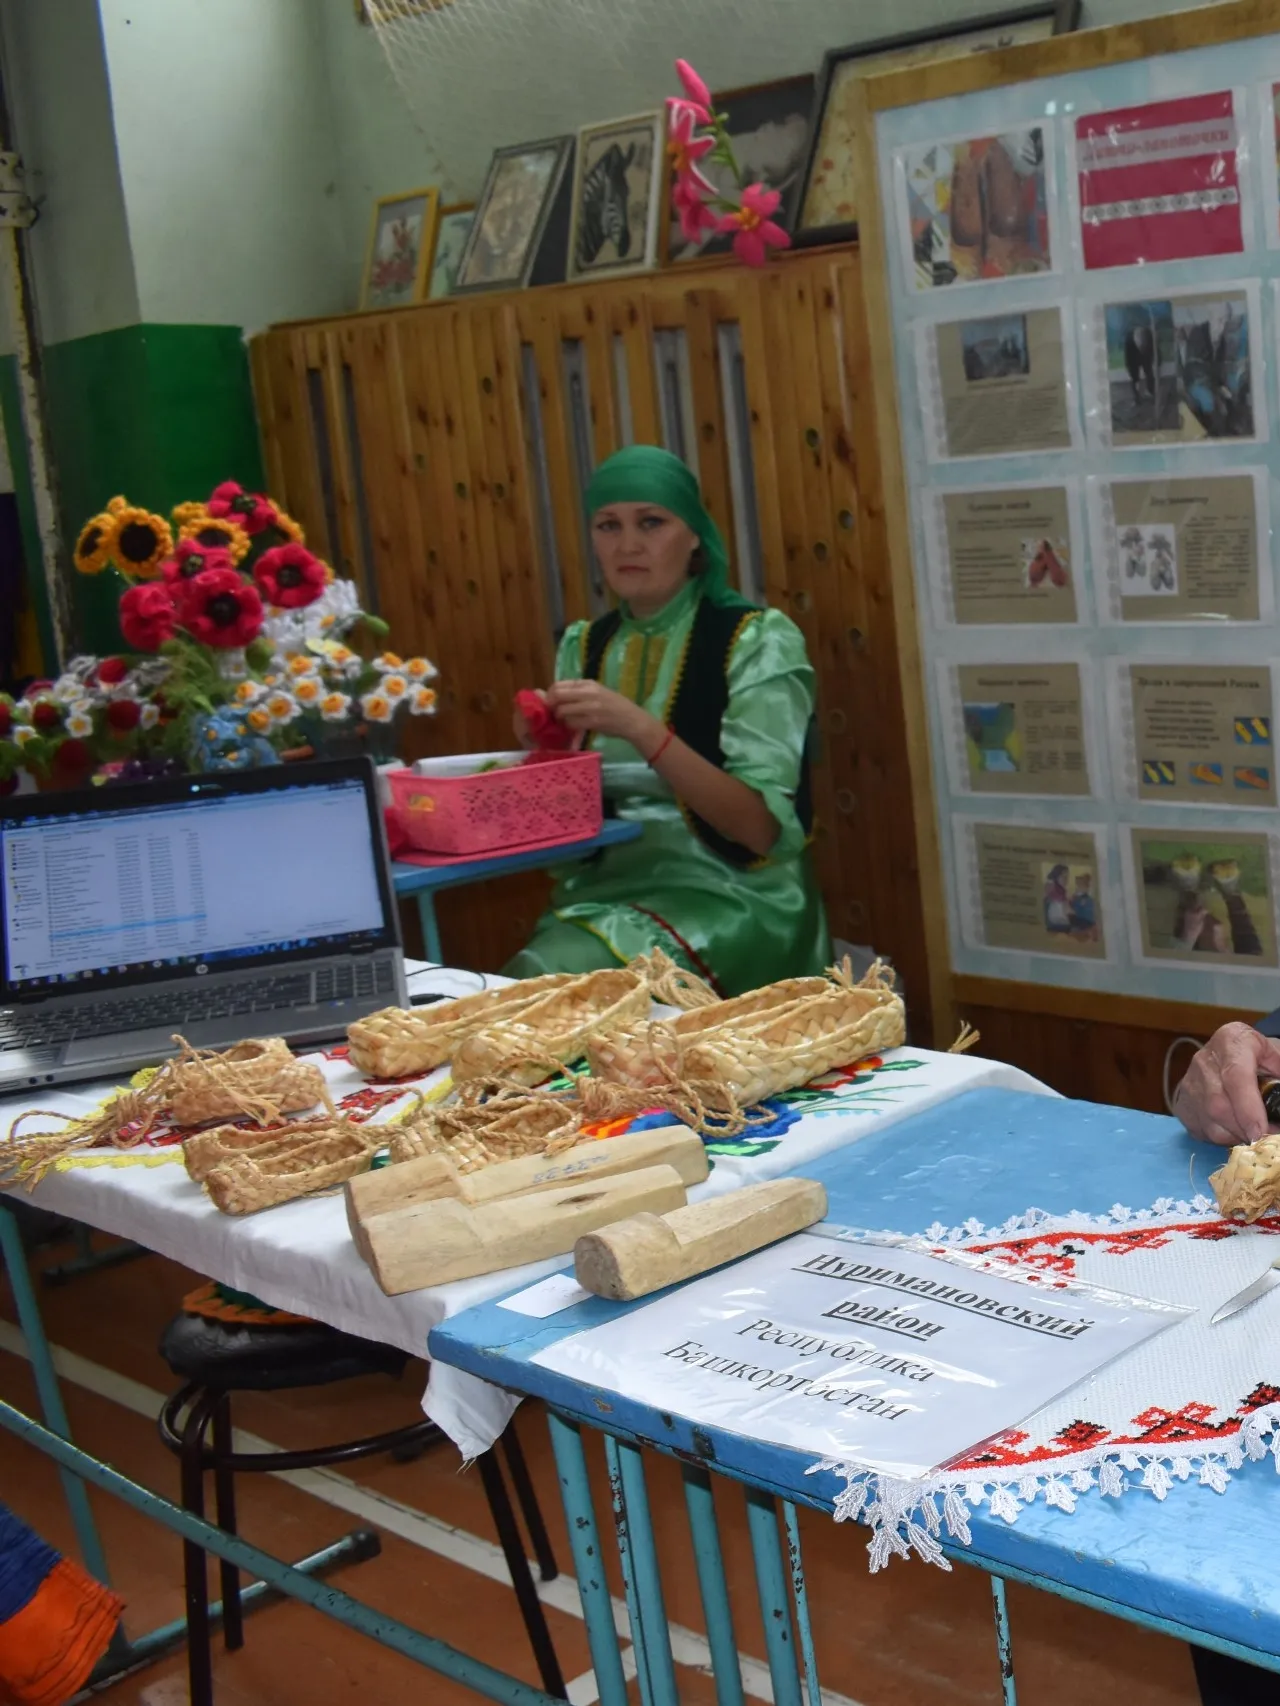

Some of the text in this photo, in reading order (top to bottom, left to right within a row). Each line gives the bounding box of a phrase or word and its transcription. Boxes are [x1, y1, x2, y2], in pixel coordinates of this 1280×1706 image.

[800, 1253, 1096, 1338] Нуримановский
[825, 1301, 945, 1338] район
[661, 1340, 911, 1421] Башкортостан
[735, 1319, 936, 1383] Республика
